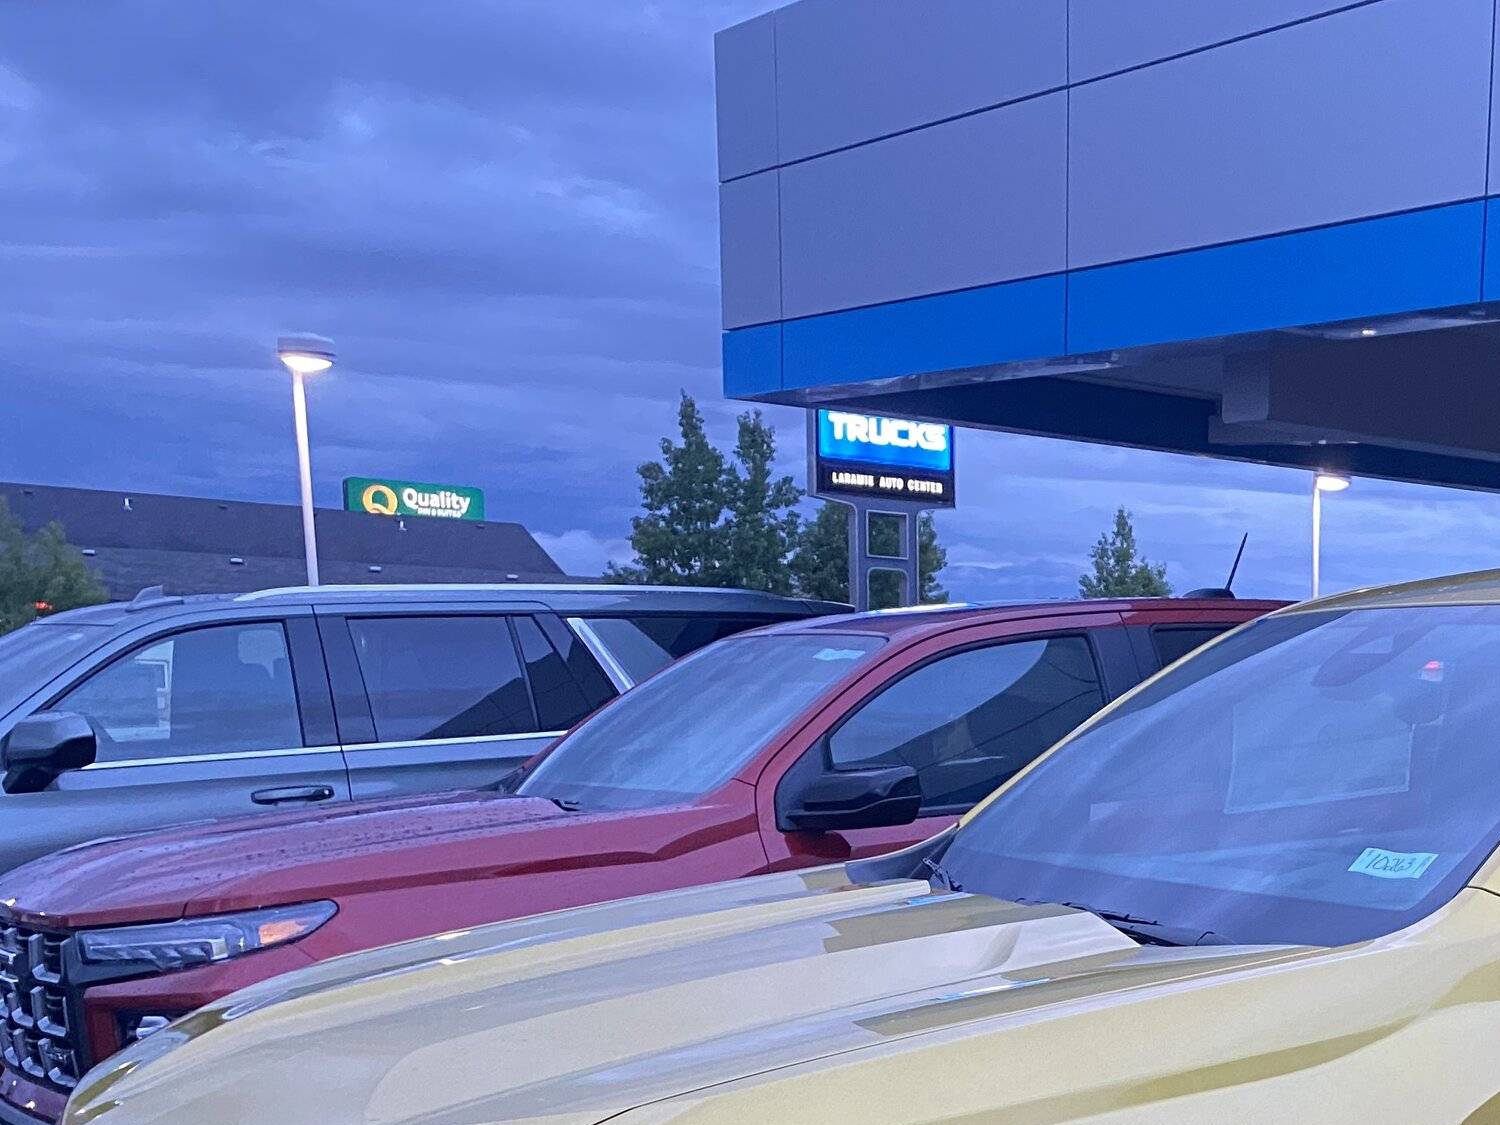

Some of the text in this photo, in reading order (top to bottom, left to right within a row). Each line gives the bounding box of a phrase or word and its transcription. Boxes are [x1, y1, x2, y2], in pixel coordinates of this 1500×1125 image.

[827, 411, 947, 452] TRUCKS
[831, 471, 944, 495] LARAMIE AUTO CENTER
[402, 487, 471, 514] Quality
